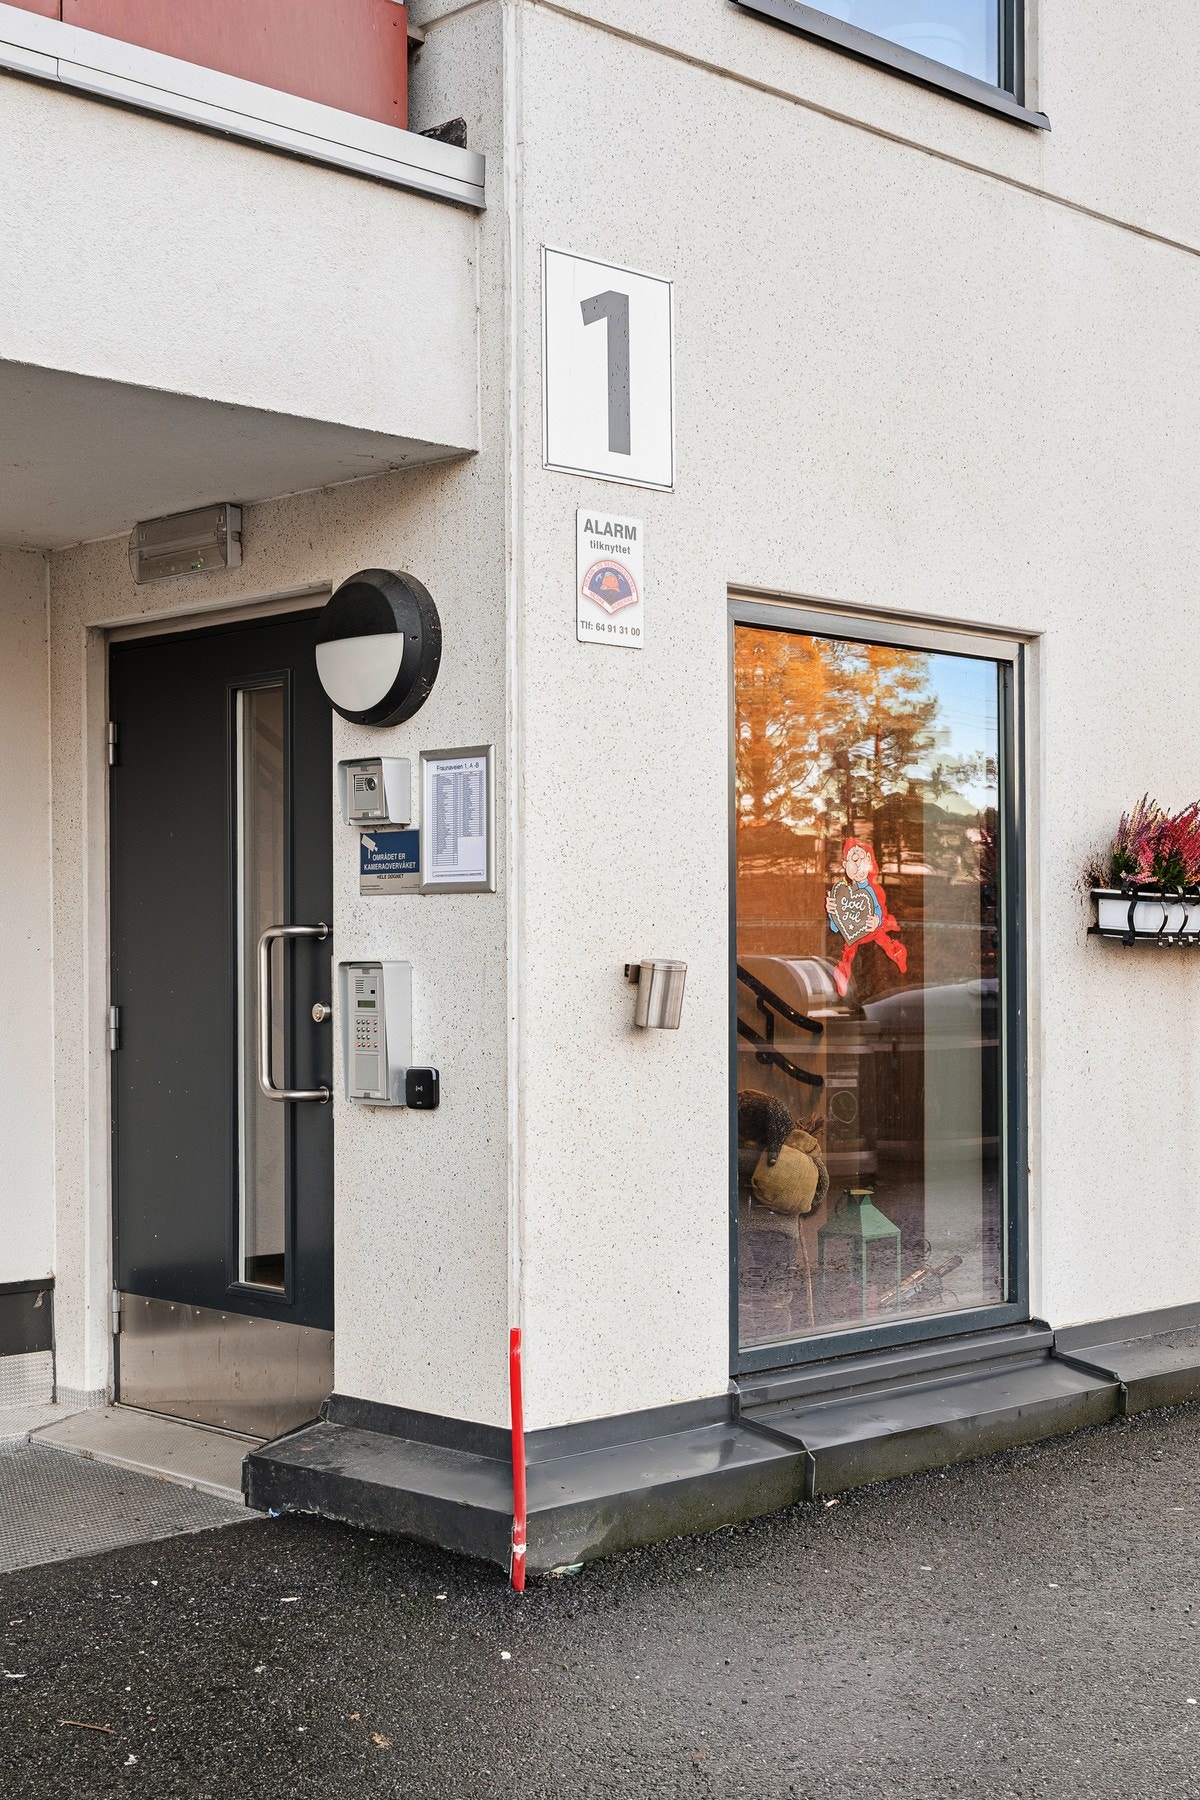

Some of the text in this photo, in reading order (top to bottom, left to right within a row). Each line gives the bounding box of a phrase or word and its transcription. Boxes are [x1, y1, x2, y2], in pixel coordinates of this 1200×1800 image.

[580, 290, 631, 456] 1
[583, 518, 637, 541] ALARM
[590, 540, 631, 554] tilknyttet
[580, 620, 641, 637] Tlf: 64 91 31 00
[372, 852, 406, 861] OMRÅDET ER
[363, 860, 417, 871] KAMERAOVERVÅKET
